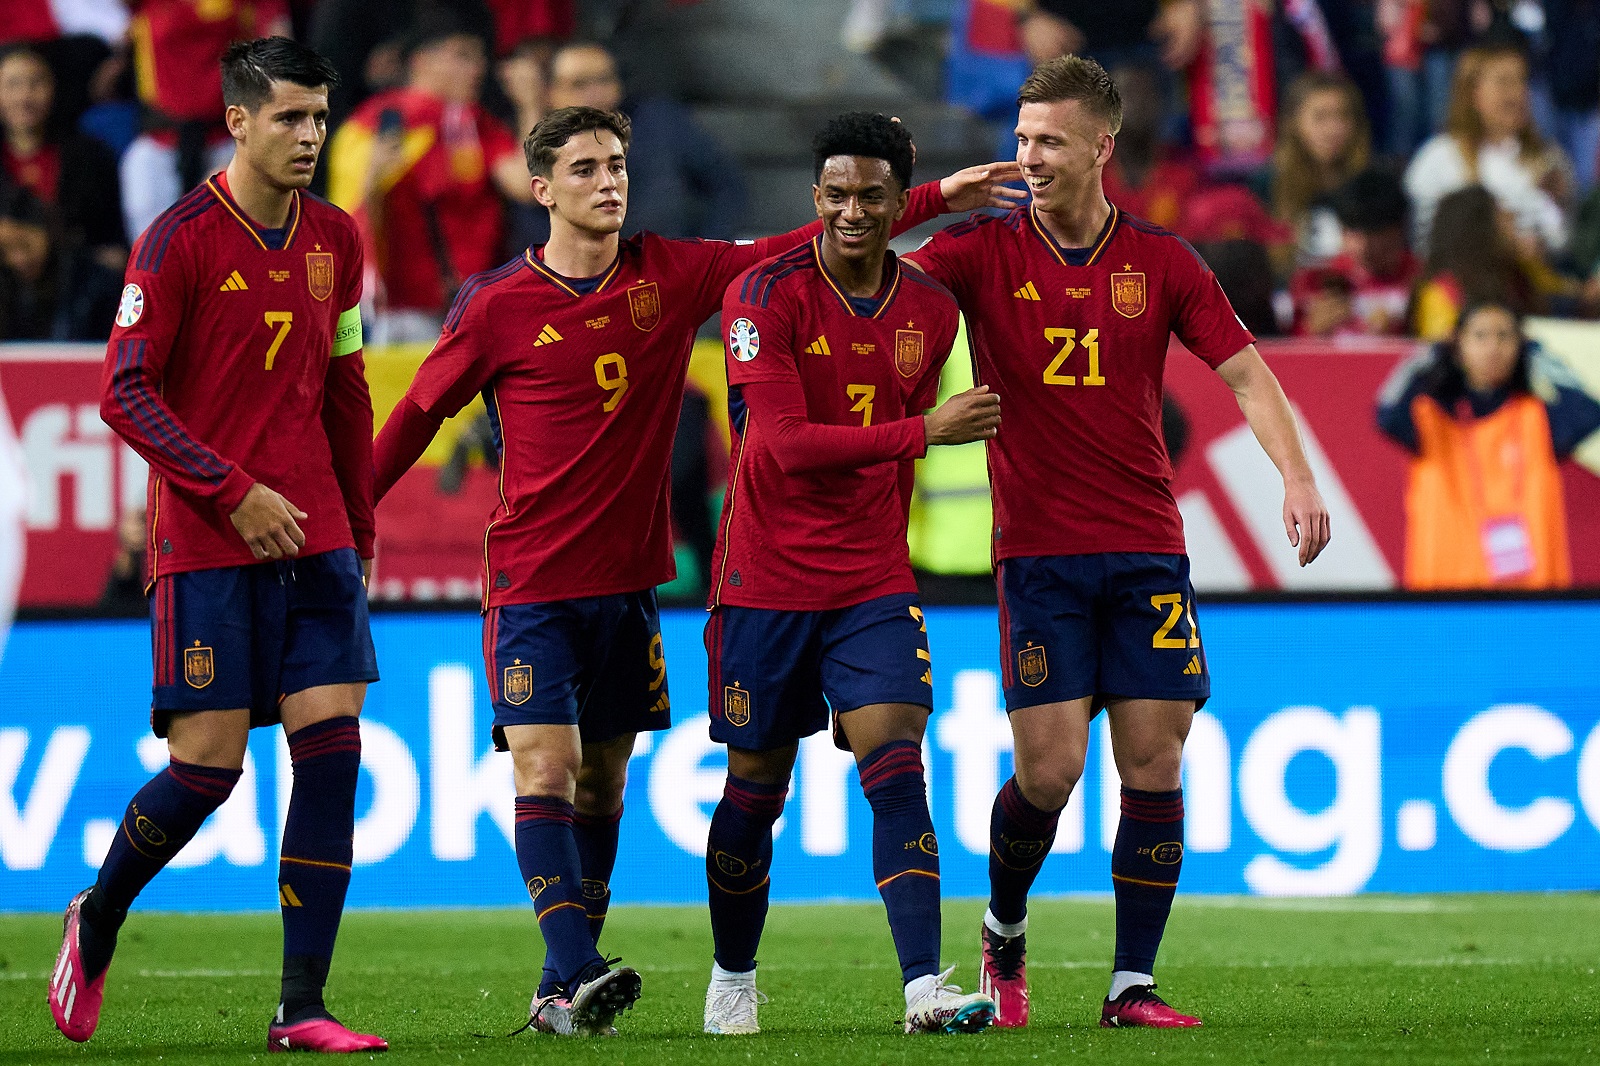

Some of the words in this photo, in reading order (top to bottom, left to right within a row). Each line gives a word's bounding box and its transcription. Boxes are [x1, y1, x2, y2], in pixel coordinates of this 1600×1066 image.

[264, 312, 293, 371] 7
[1042, 327, 1106, 387] 21
[593, 352, 629, 413] 9
[846, 384, 876, 427] 3
[1150, 592, 1200, 649] 21
[648, 632, 666, 691] 9
